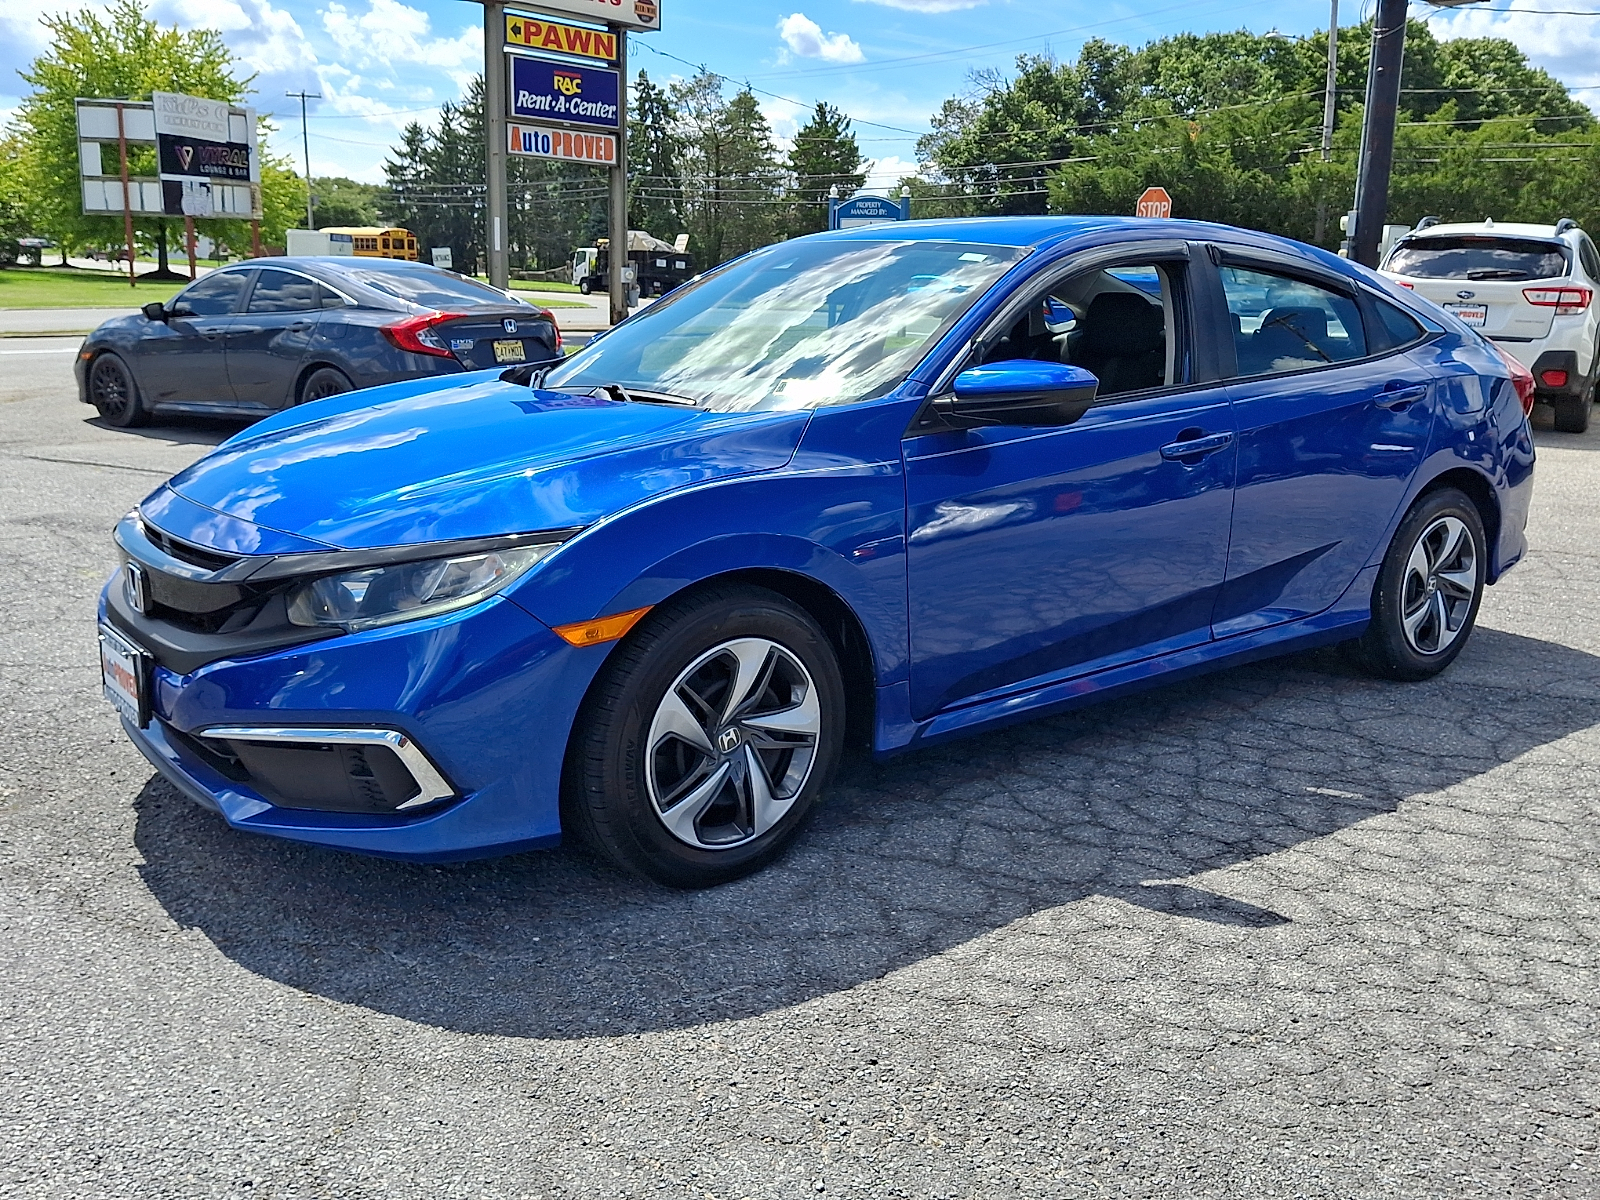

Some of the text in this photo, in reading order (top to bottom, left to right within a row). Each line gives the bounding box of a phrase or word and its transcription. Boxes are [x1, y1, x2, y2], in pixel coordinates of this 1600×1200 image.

[524, 21, 613, 57] PAWN
[554, 76, 581, 95] RAC
[1139, 202, 1169, 218] STOP
